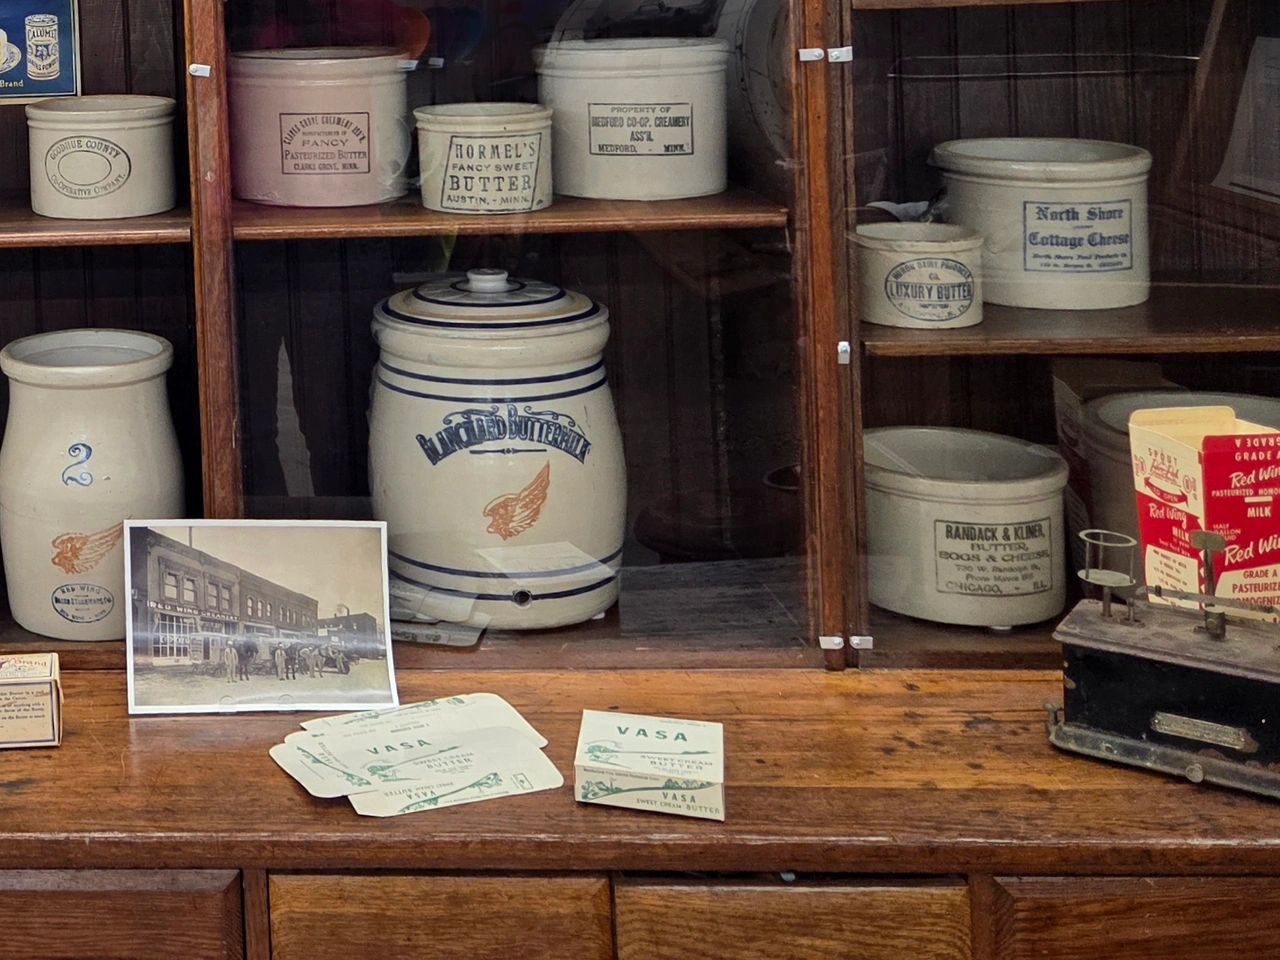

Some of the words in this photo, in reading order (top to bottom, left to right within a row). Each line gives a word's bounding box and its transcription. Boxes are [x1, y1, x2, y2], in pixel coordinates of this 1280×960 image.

[27, 27, 58, 41] CALUMET
[0, 79, 24, 88] Brand
[611, 106, 656, 114] PROPERTY
[660, 106, 672, 114] OF
[654, 116, 690, 128] CREAMERY
[49, 138, 83, 160] GOODHUE
[85, 138, 122, 160] COUNTY
[302, 139, 349, 148] FANCY
[455, 141, 535, 160] HORMEL'S
[284, 149, 336, 161] PASTEURIZED
[337, 149, 368, 160] BUTTER
[451, 162, 492, 173] FANCY
[494, 161, 535, 173] SWEET
[448, 174, 532, 193] BUTTER
[1035, 206, 1080, 221] North
[1086, 206, 1124, 221] Shore
[1028, 231, 1085, 250] Cottage
[1087, 231, 1130, 247] Cheese
[889, 283, 933, 299] LUXURY
[937, 283, 972, 300] BUTTER
[1235, 451, 1272, 462] GRADE
[61, 442, 94, 487] 2
[1229, 470, 1256, 489] Red
[1258, 463, 1280, 482] Win
[1211, 489, 1254, 497] PASTEURIZED
[1148, 503, 1165, 518] Red
[1166, 506, 1188, 530] Wing
[1247, 506, 1272, 518] MILK
[945, 524, 999, 542] RANDACK
[1002, 526, 1011, 541] &
[1172, 526, 1190, 542] MILK
[938, 550, 982, 563] EGGS
[985, 554, 998, 563] &
[1224, 541, 1254, 566] Red
[1242, 568, 1269, 579] GRADE
[1272, 568, 1278, 578] A
[1232, 584, 1280, 595] PASTEURIZE
[616, 725, 688, 742] VASA
[365, 738, 433, 755] VASA
[649, 760, 703, 771] BUTTER
[661, 791, 697, 804] VASA
[636, 797, 659, 807] SWEET
[685, 804, 721, 815] BUTTER
